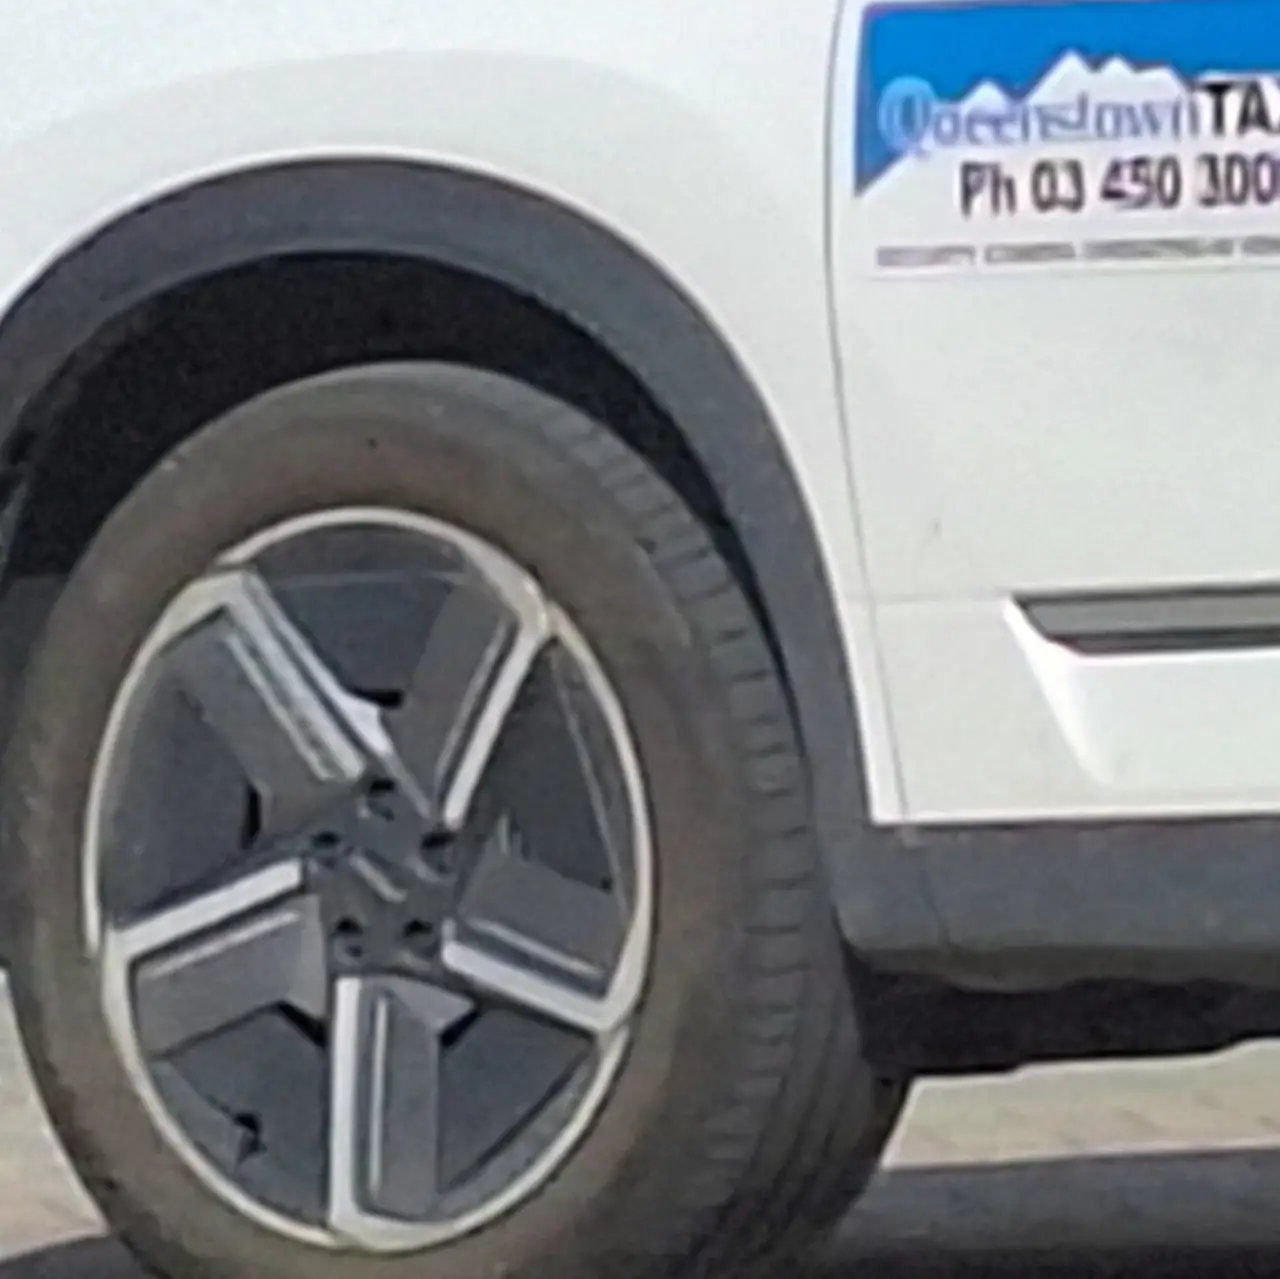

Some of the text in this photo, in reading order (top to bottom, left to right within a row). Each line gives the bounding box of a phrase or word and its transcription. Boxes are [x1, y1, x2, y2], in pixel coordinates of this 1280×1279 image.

[961, 160, 1015, 216] Ph
[1031, 160, 1084, 212] 03
[1100, 156, 1181, 209] 450
